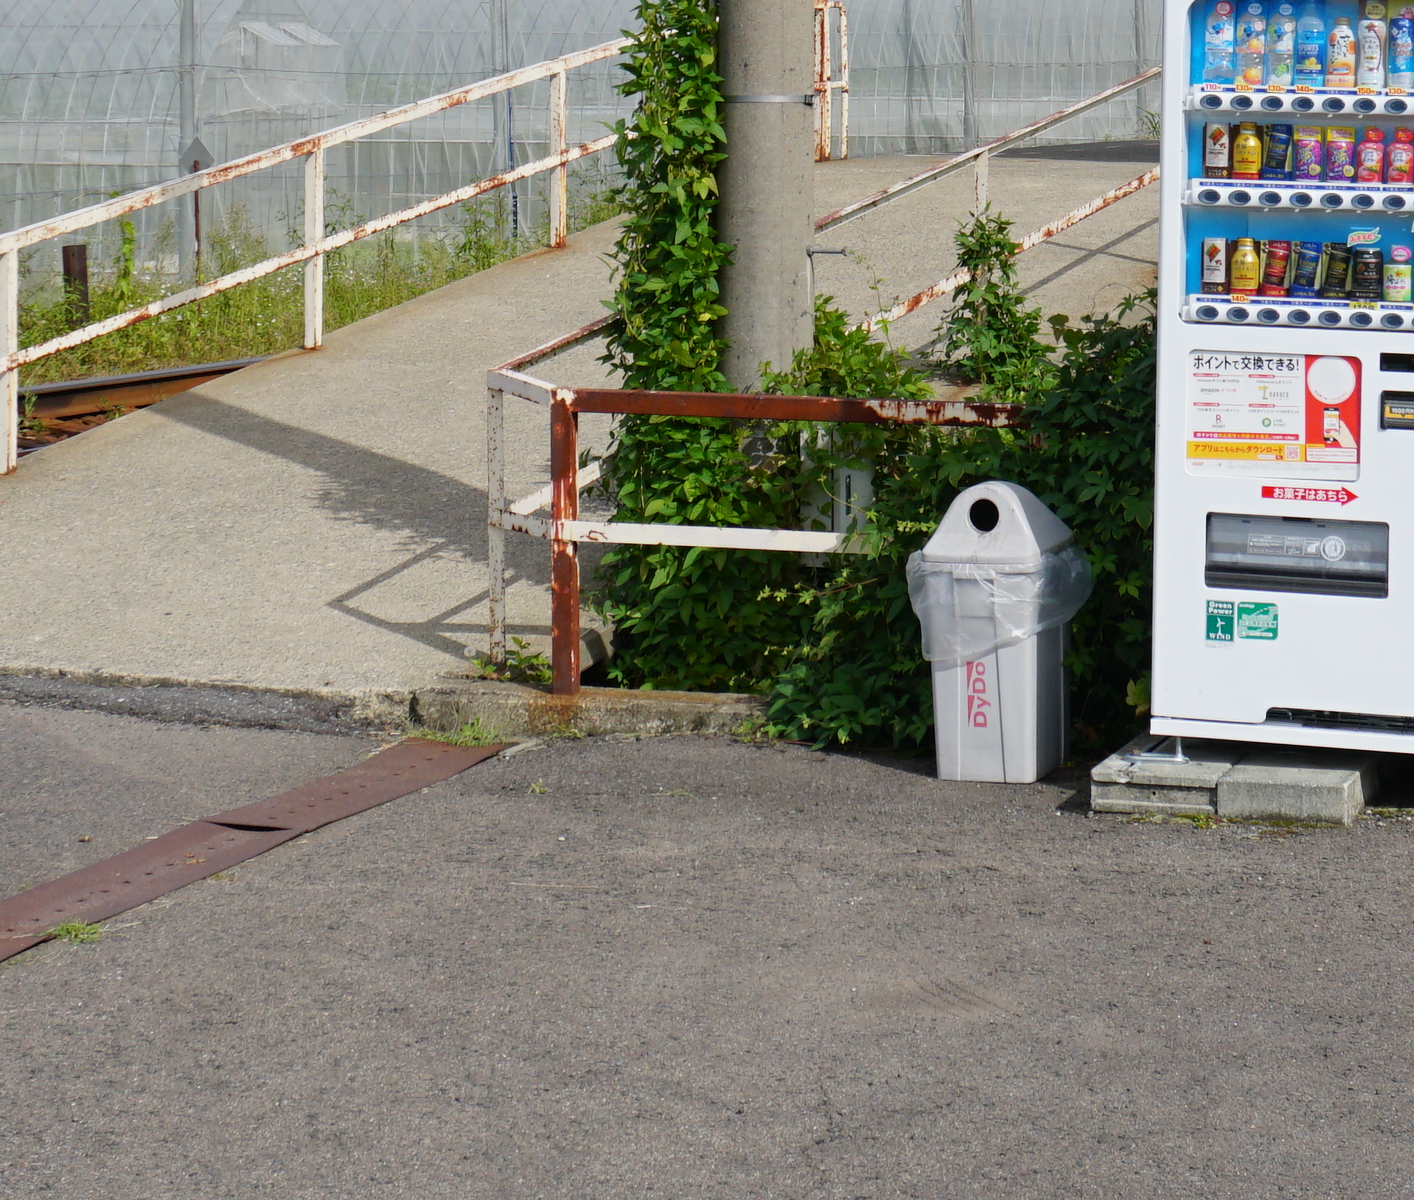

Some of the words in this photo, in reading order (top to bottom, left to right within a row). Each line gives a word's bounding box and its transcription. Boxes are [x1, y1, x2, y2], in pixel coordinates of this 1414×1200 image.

[1193, 355, 1300, 371] ポイントで交換できる!
[1193, 444, 1284, 454] アプリはこちらからダウンロード
[1273, 487, 1348, 502] お菓子はあちら
[1209, 601, 1232, 609] Green
[1209, 632, 1231, 640] WIND
[973, 661, 991, 728] DyDo
